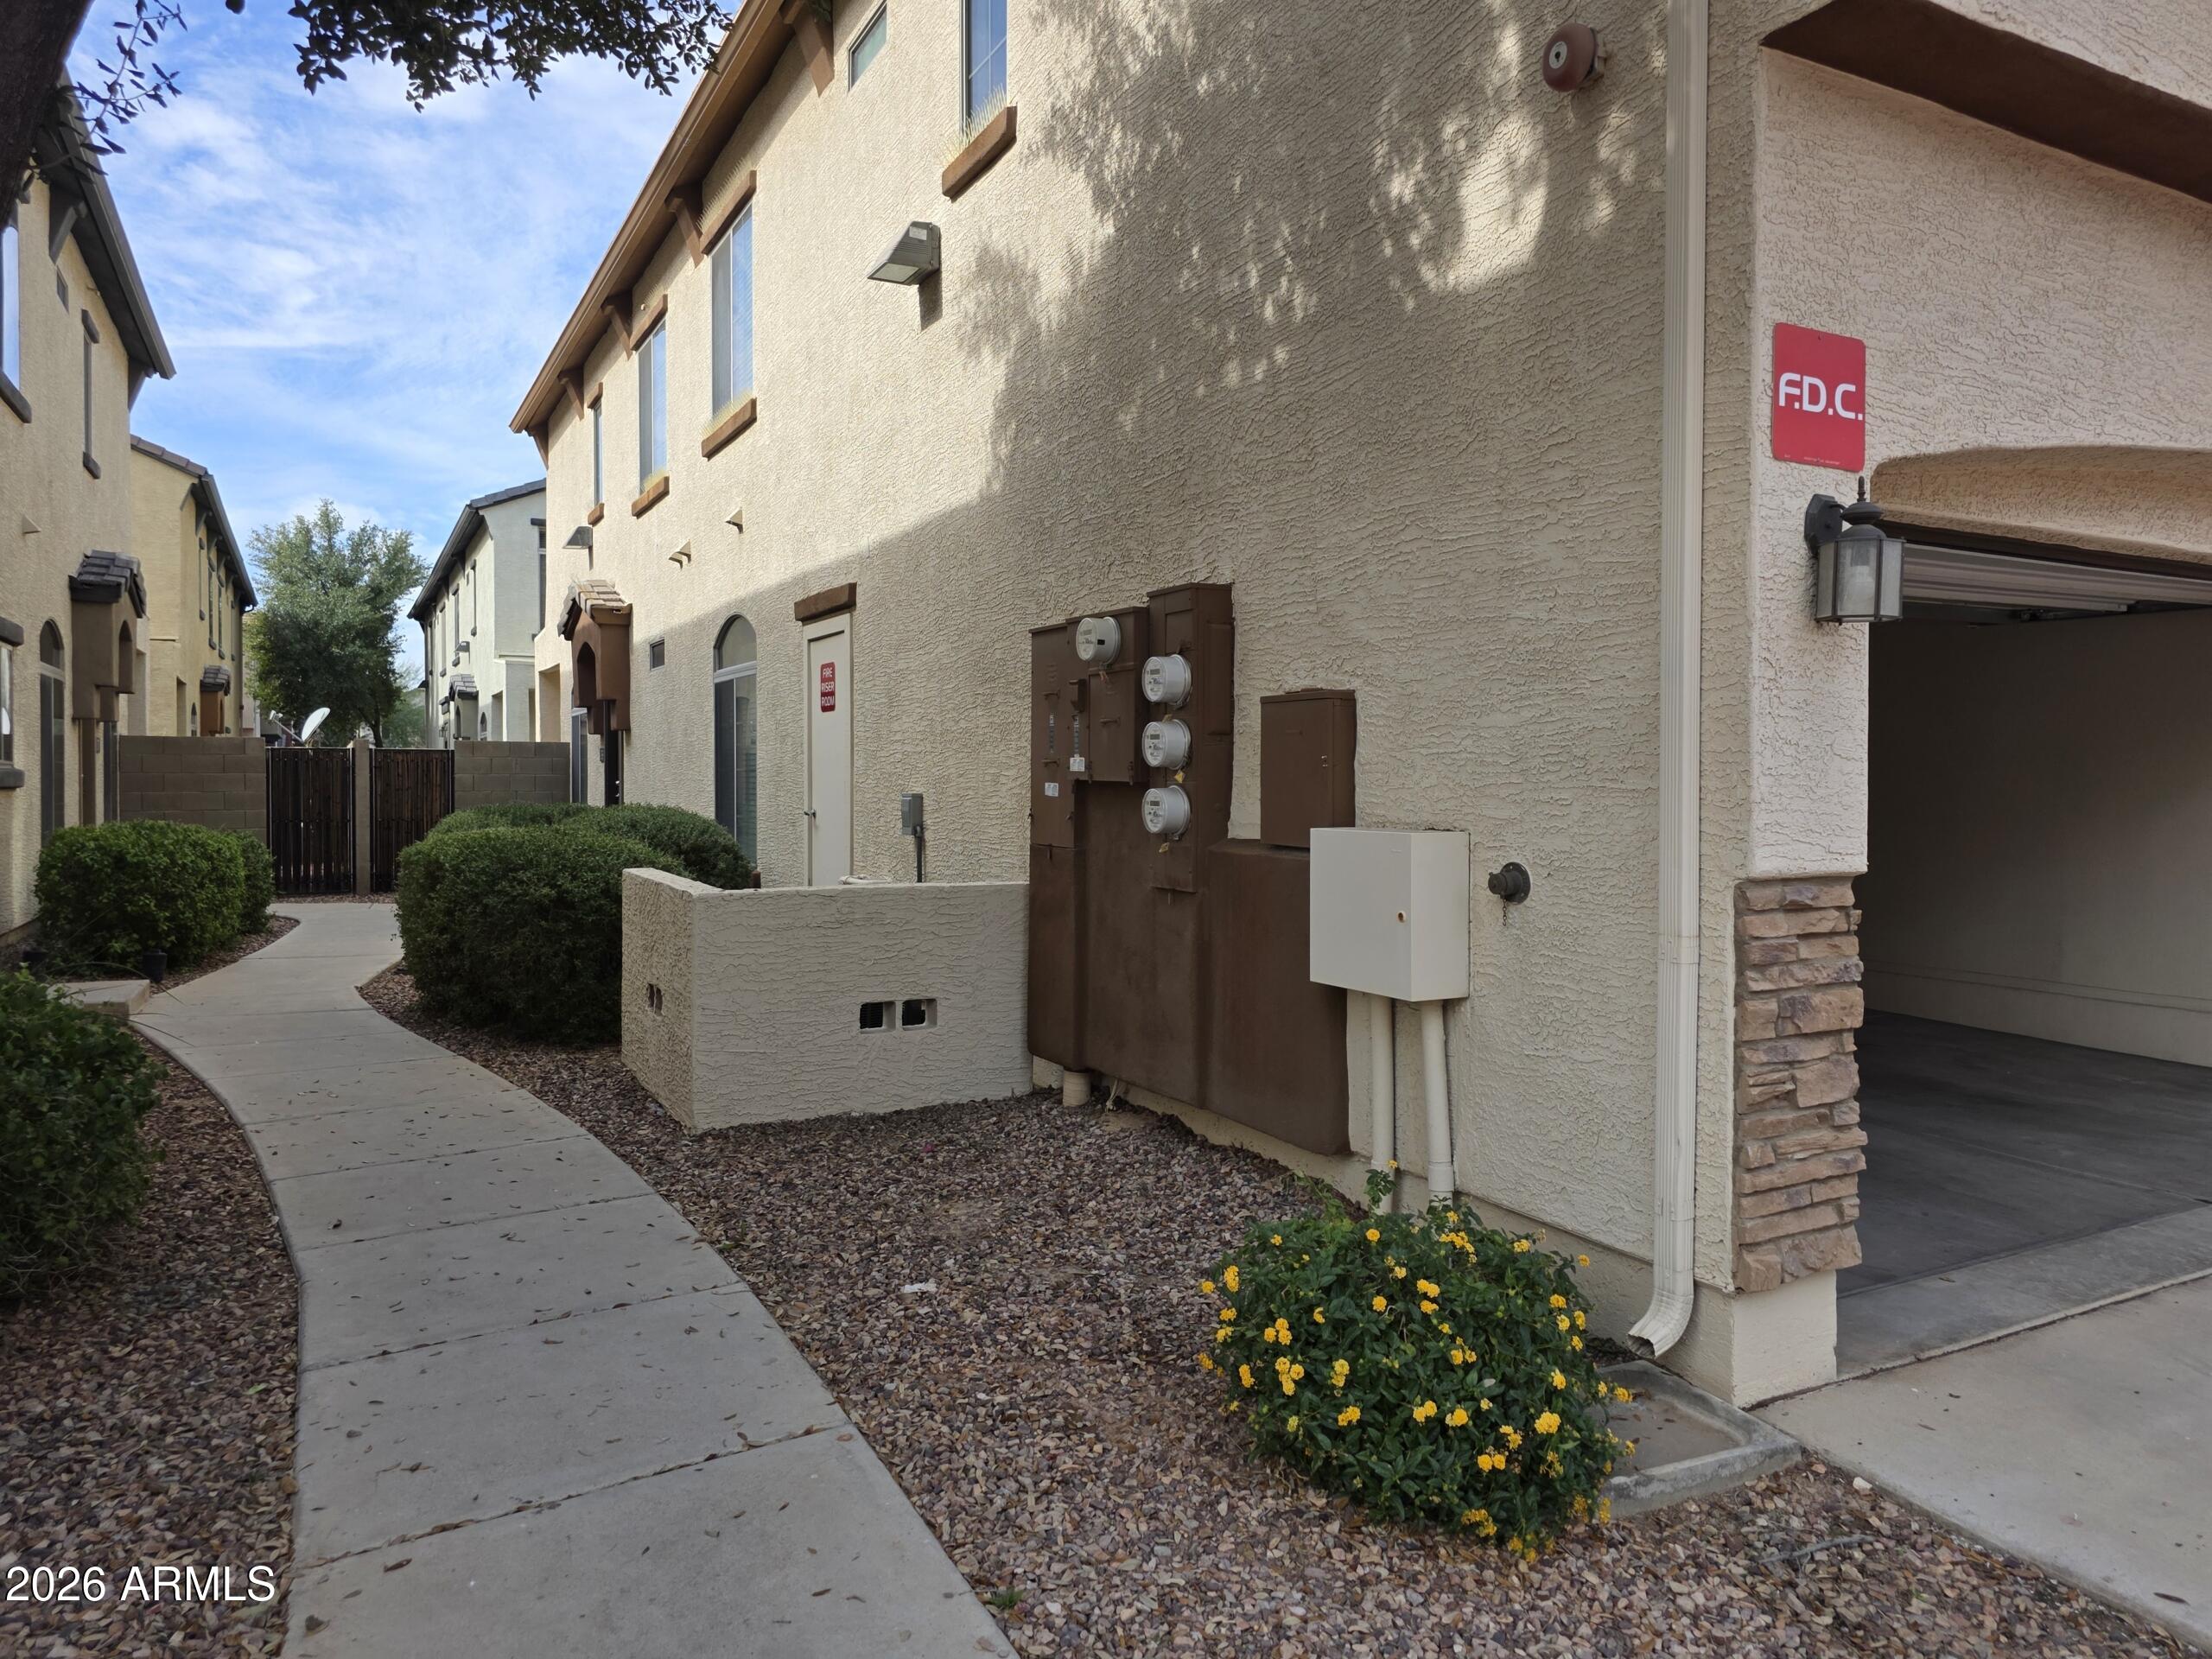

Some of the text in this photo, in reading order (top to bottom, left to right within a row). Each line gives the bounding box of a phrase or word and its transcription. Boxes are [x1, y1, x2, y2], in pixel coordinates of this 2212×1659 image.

[1779, 372, 1863, 421] F.D.C.
[823, 667, 833, 677] FIRE
[821, 682, 835, 692] RISER
[821, 696, 835, 706] ROOM
